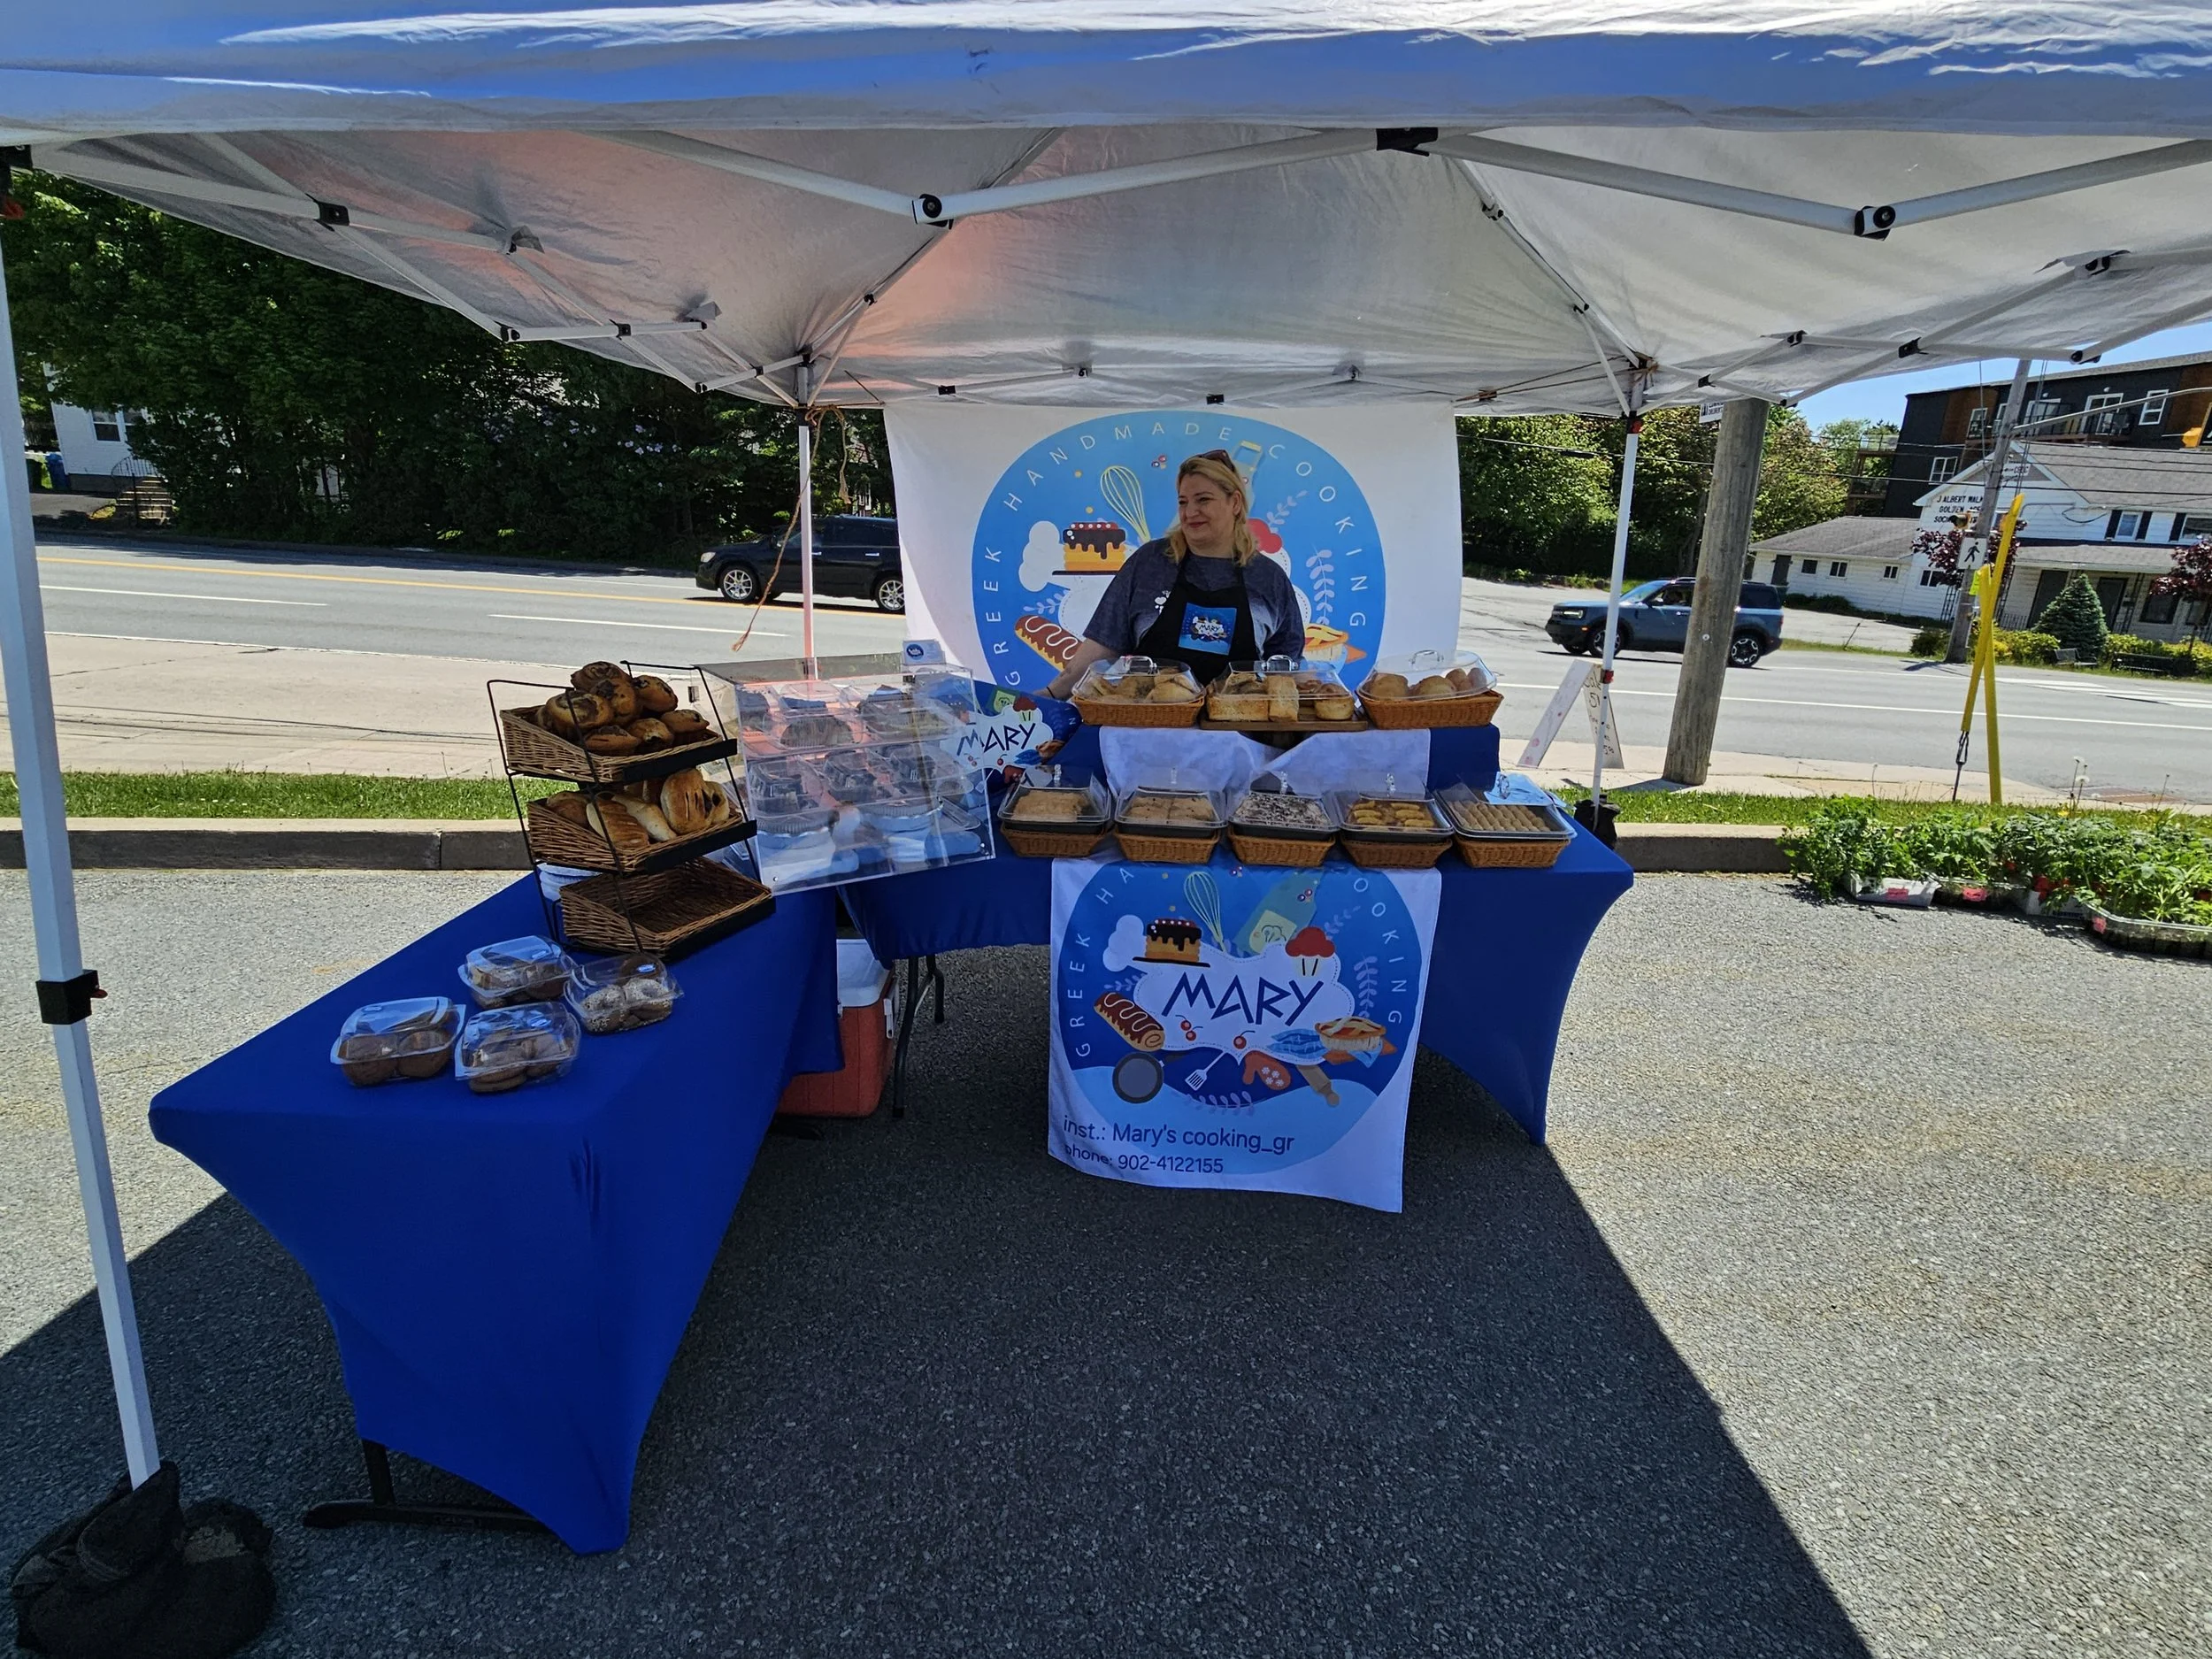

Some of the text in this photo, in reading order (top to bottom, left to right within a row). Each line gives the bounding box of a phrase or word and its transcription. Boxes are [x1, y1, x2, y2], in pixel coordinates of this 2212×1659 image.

[984, 422, 1368, 687] GREEK HANDMADE COOKING
[1199, 624, 1220, 633] MARY
[956, 723, 1036, 756] MARY
[1068, 933, 1091, 1056] GREEK
[1340, 871, 1407, 1024] OOKING
[1162, 972, 1324, 1026] MARY
[1112, 1123, 1177, 1148] Mary's
[1182, 1127, 1295, 1155] cooking_gr
[1064, 1143, 1224, 1174] phone: 902-4122155
